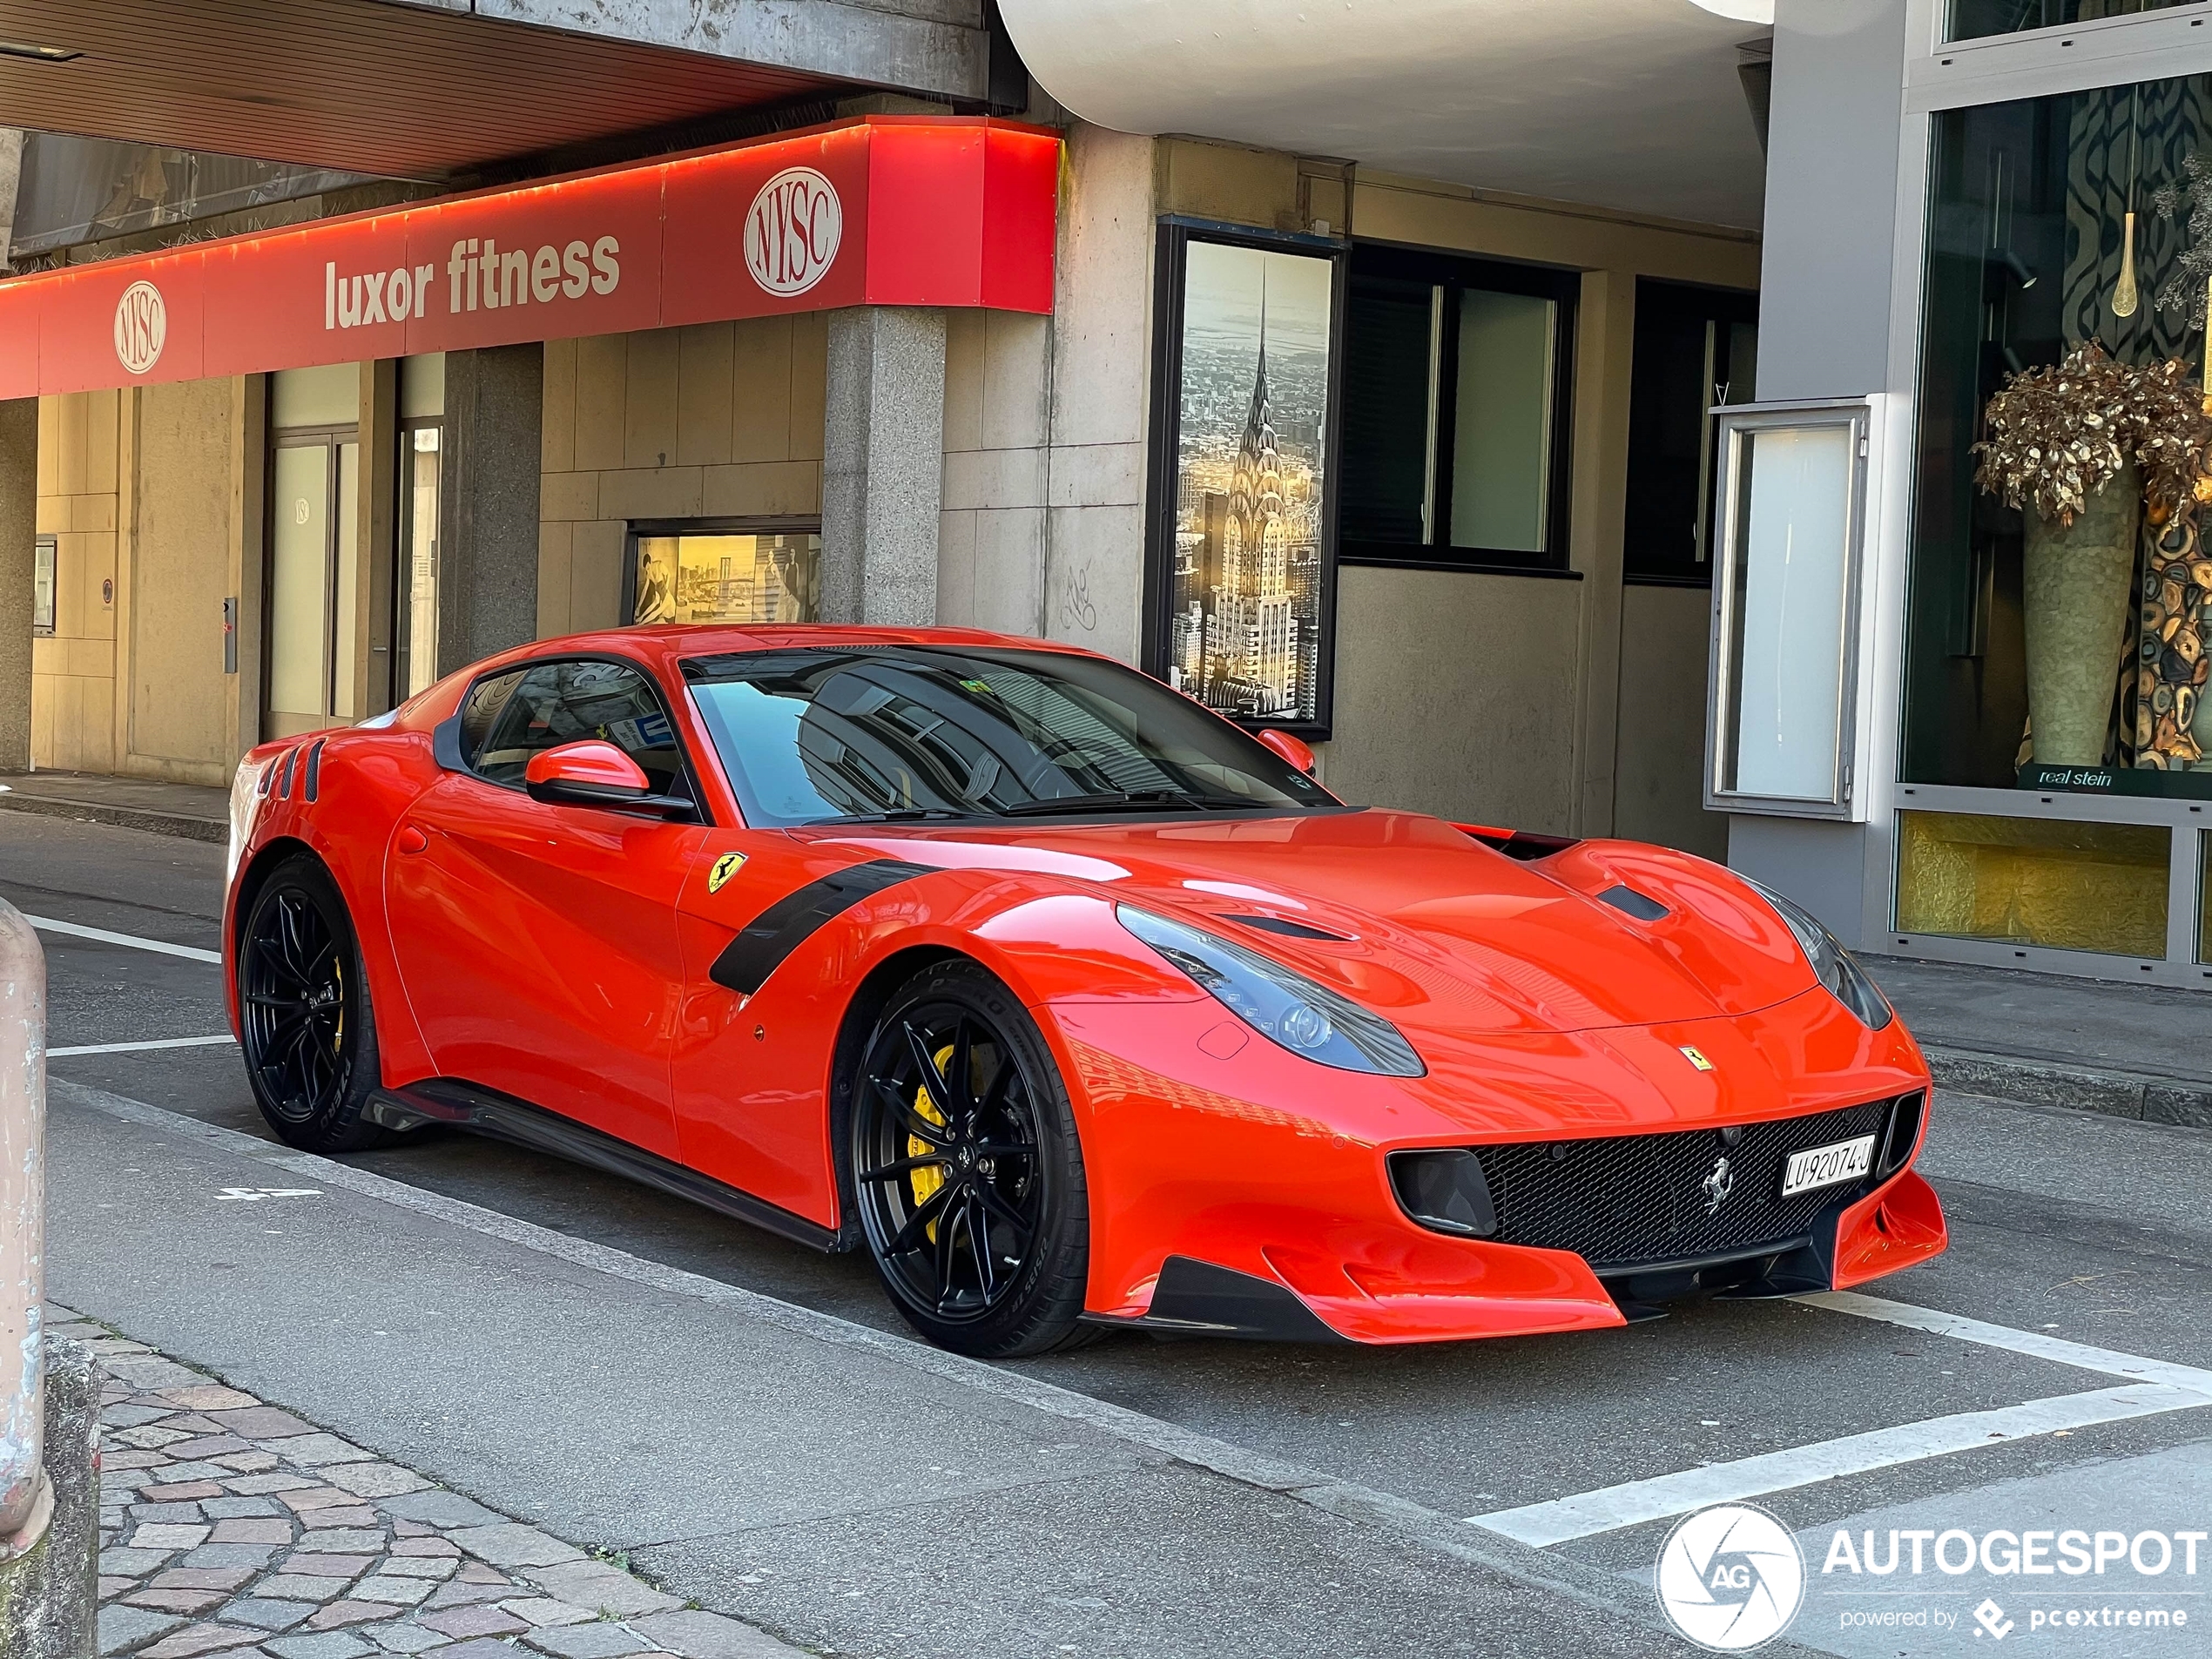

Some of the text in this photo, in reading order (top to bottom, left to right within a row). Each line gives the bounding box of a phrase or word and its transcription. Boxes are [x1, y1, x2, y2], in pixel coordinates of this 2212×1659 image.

[756, 180, 829, 284] NYSC
[325, 236, 620, 330] luxor fitness
[120, 290, 160, 365] NYSC
[2039, 769, 2113, 786] real stein
